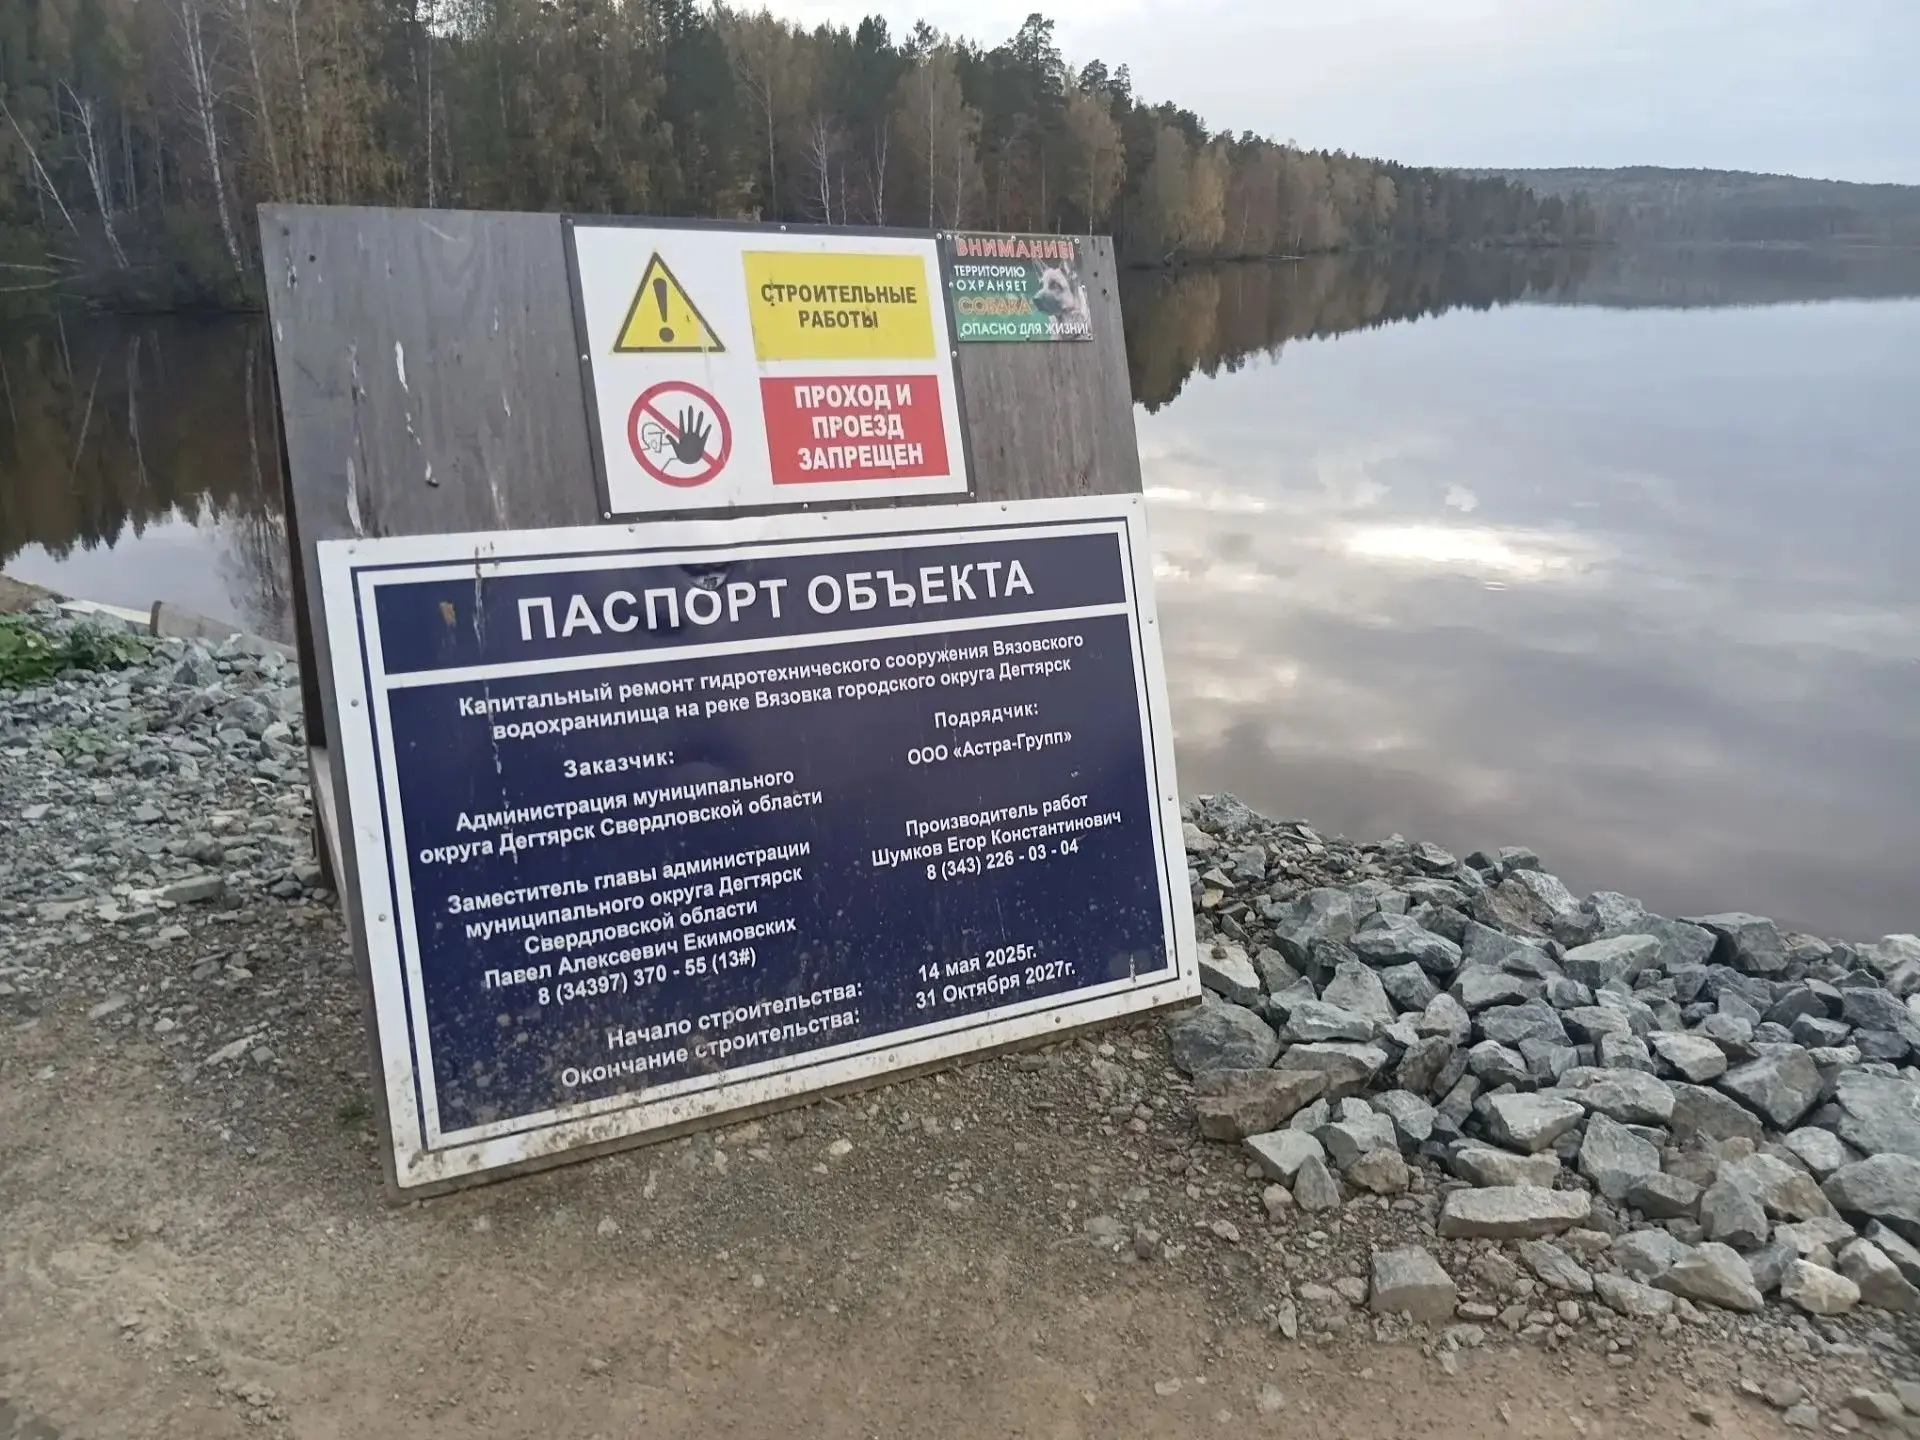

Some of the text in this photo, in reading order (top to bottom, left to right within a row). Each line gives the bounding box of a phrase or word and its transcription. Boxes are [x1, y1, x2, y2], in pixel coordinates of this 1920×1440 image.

[954, 265, 1025, 277] ТЕРРИТОРИЮ
[955, 238, 1075, 261] ВНИМАНИЕ!
[761, 284, 917, 304] СТРОИТЕЛЬНЫЕ
[956, 280, 1027, 291] ОХРАНЯЕТ
[958, 295, 1032, 315] СОБАКА
[798, 310, 879, 329] РАБОТЫ
[962, 323, 1088, 335] ОПАСНО ДЛЯ ЖИЗНИ!
[794, 383, 912, 408] ПРОХОД И
[812, 414, 904, 439] ПРОЕЗД
[798, 444, 923, 471] ЗАПРЕЩЕН
[518, 559, 1034, 641] ПАСПОРТ ОБЪЕКТА
[459, 633, 1083, 717] Капитальный ремонт гидротехнического сооружения Вязовского
[493, 658, 1071, 741] водохранилища на реке Вязовка городского округа Дегтярск
[934, 703, 1039, 729] Подрядчик:
[564, 751, 674, 778] Заказчик:
[908, 730, 1072, 765] ООО «Астра-Групп»
[456, 769, 794, 831] Администрация муниципального
[905, 793, 1088, 839] Производитель работ
[420, 790, 823, 867] округа Дегтярск Свердловской области
[871, 810, 1121, 867] Шумков Егор Константинович
[447, 839, 811, 915] Заместитель главы администрации
[926, 864, 936, 881] 8
[942, 856, 981, 882] (343)
[986, 850, 1014, 870] 226
[1029, 845, 1046, 861] 03
[1061, 839, 1078, 856] 04
[465, 867, 803, 940] муниципального округа Дегтярск
[524, 899, 758, 954] Свердловской области
[485, 917, 797, 990] Павел Алексеевич Екимовских
[918, 944, 1037, 983] 14 мая 2025г.
[538, 986, 550, 1004] 8
[556, 972, 628, 1006] (34397)
[634, 963, 667, 986] 370
[685, 956, 706, 976] 55
[712, 947, 757, 975] (13#)
[915, 960, 1076, 1010] 31 Октября 2027г.
[607, 982, 863, 1049] Начало строительства:
[561, 1008, 861, 1088] Окончание строительства:
